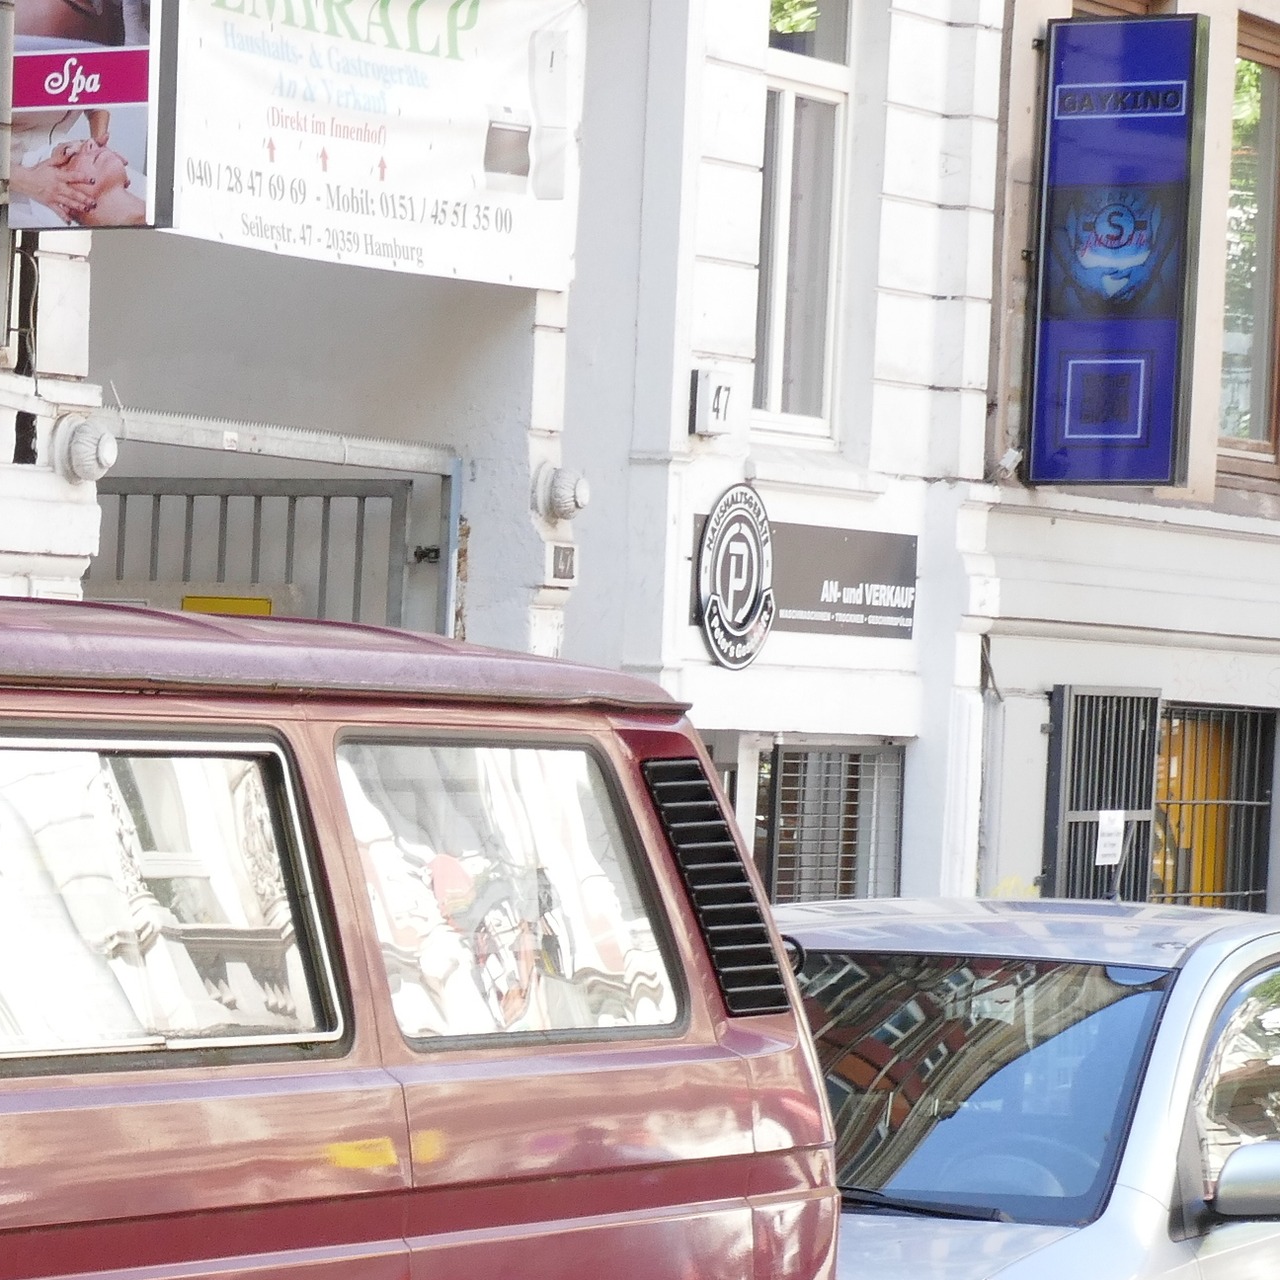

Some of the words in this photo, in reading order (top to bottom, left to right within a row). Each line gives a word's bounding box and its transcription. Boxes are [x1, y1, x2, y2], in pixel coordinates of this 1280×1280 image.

[44, 57, 101, 103] Spa
[309, 45, 323, 70] &
[327, 44, 430, 89] Gastrogeräte
[323, 78, 388, 115] Verkauf
[267, 106, 308, 134] (Direkt
[310, 115, 326, 136] im
[330, 120, 387, 146] Innenhof)
[186, 156, 212, 188] 040
[225, 165, 243, 194] 28
[247, 169, 263, 198] 47
[268, 173, 285, 202] 69
[290, 177, 307, 206] 69
[325, 182, 376, 217] Mobil:
[380, 191, 416, 223] 0151
[430, 199, 448, 226] 45
[451, 201, 468, 229] 51
[473, 204, 490, 231] 35
[495, 207, 513, 234] 00
[241, 212, 296, 244] Seilerstr.
[300, 224, 314, 246] 47
[325, 227, 360, 254] 20359
[363, 233, 424, 267] Hamburg
[712, 385, 731, 422] 47
[820, 580, 842, 603] AN-
[842, 583, 864, 605] und
[864, 583, 915, 609] VERKAUF
